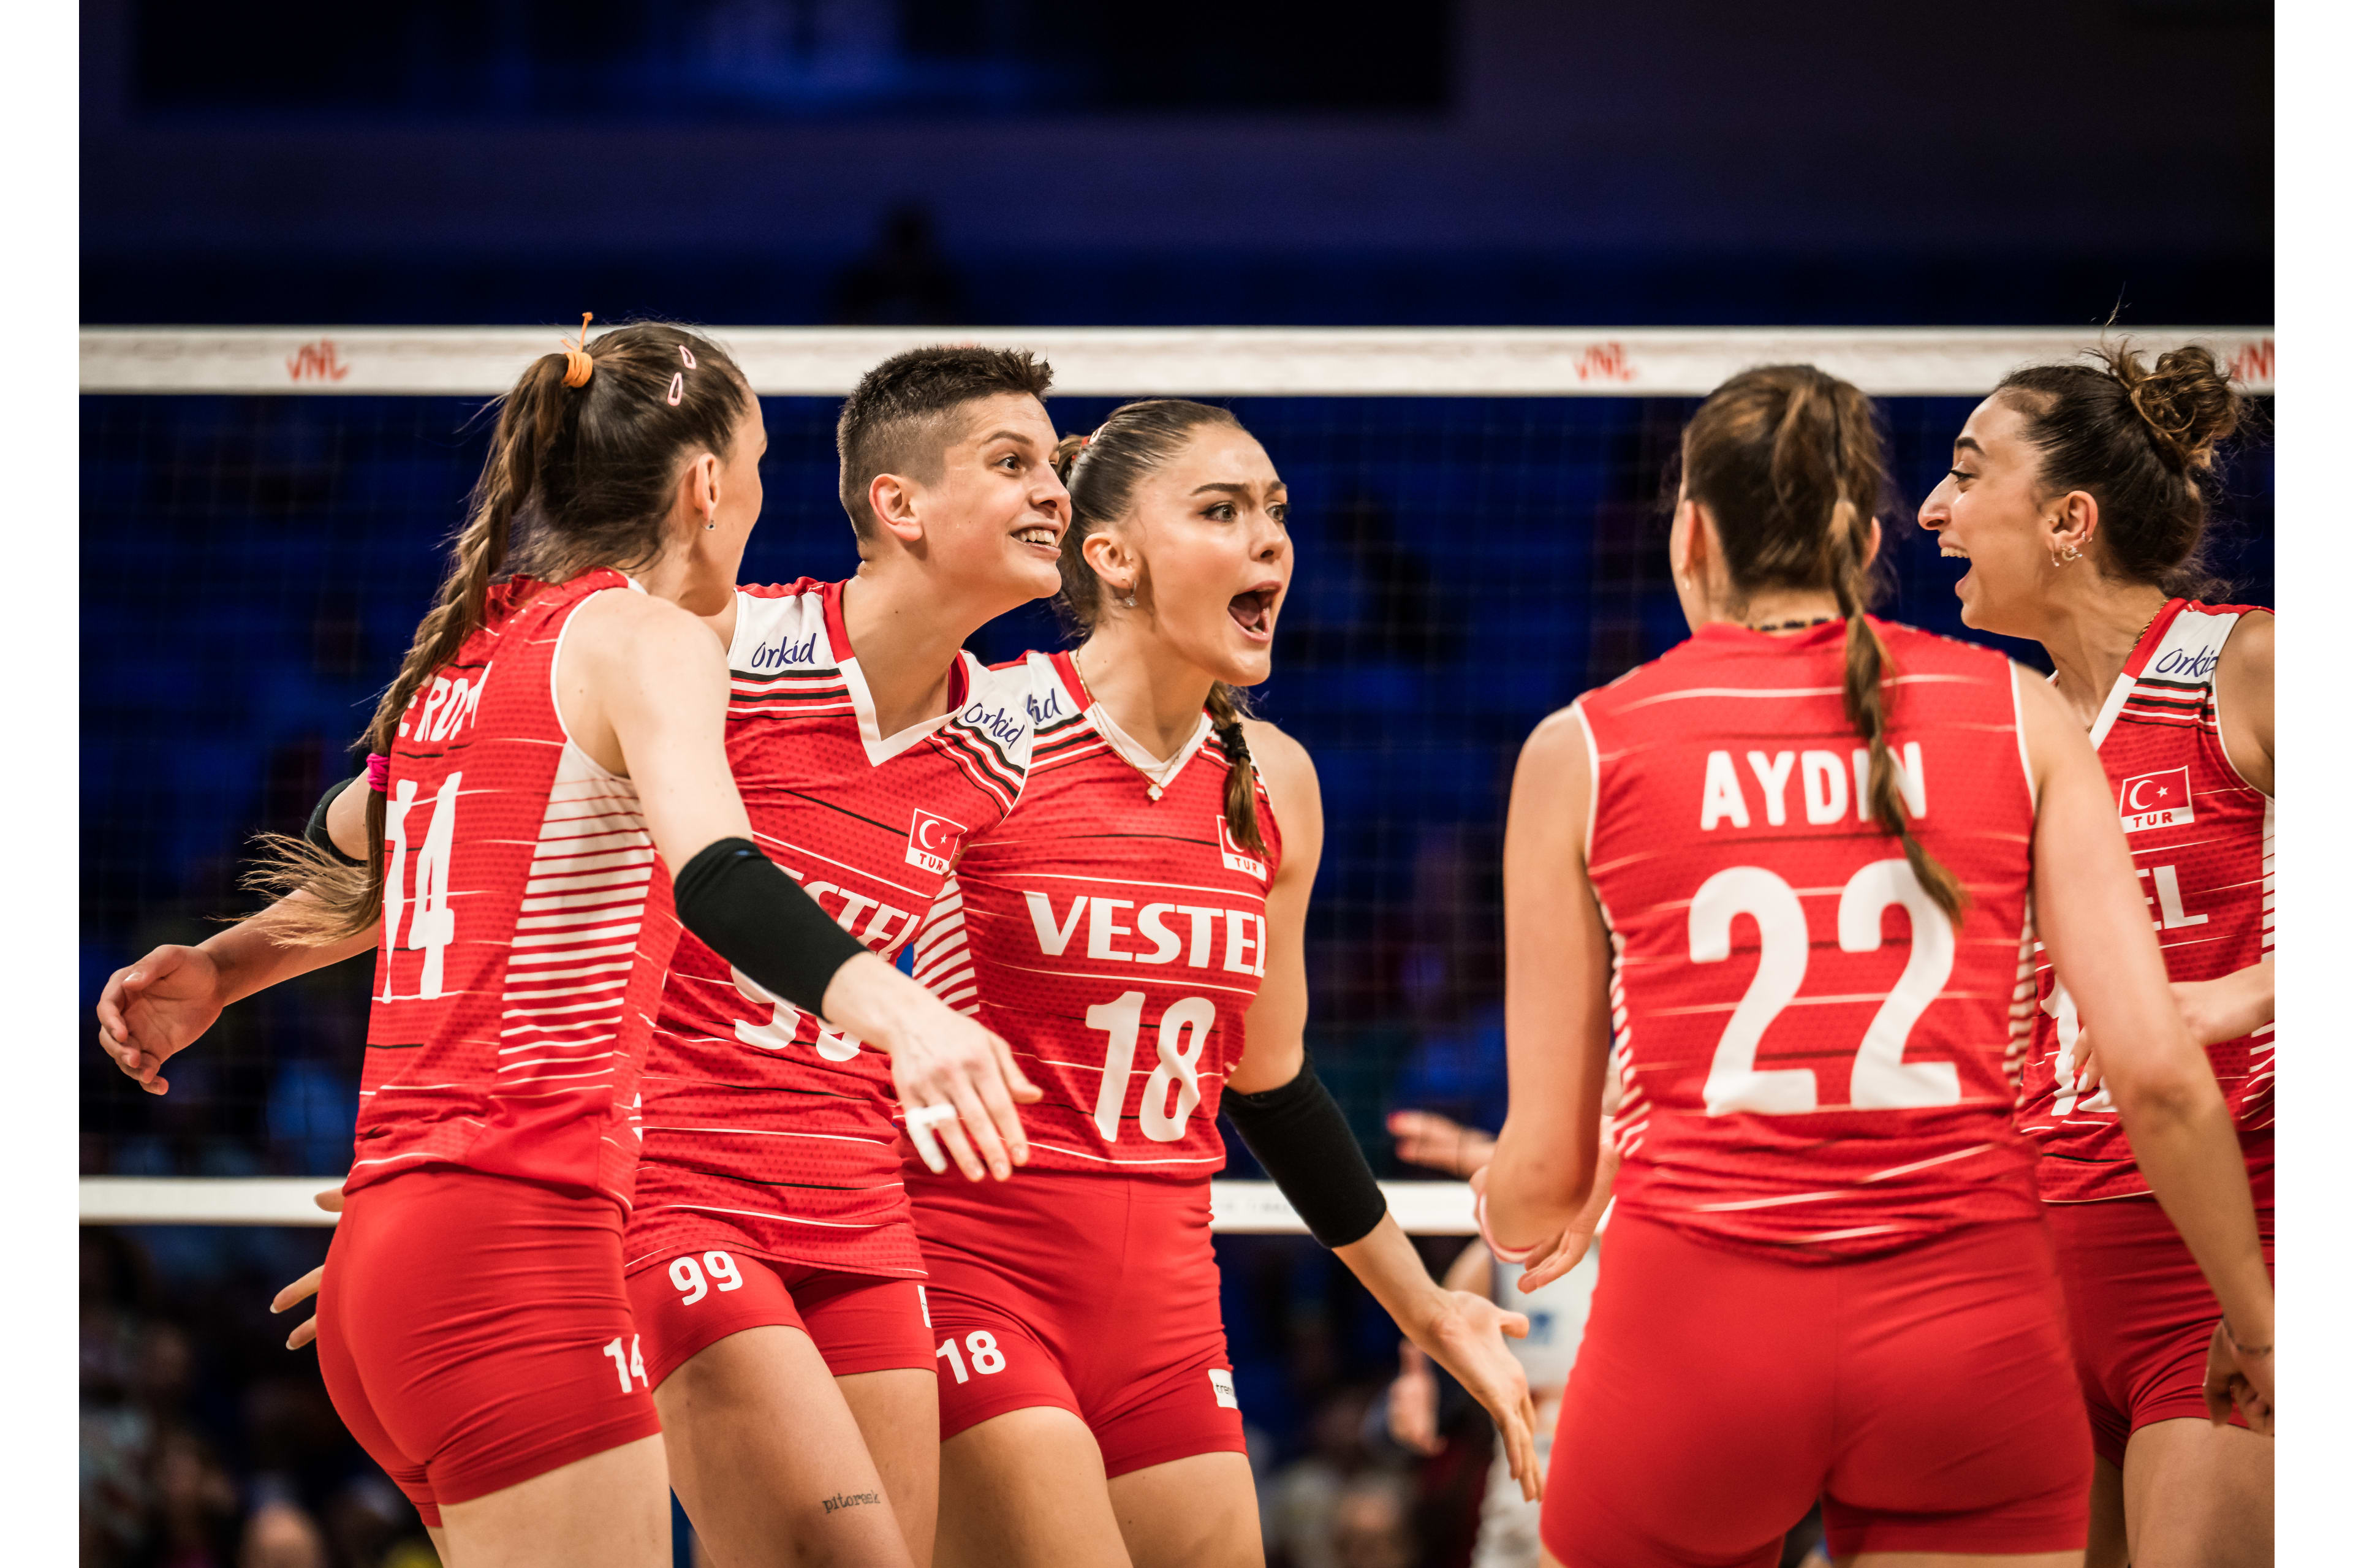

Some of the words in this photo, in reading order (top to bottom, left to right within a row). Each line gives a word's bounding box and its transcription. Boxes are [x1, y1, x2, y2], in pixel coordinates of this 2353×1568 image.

[751, 632, 817, 668] Orkid
[964, 702, 1025, 750] Orkid
[2132, 812, 2173, 828] TUR
[385, 771, 455, 1004] 14
[920, 852, 944, 871] TUR
[1234, 857, 1258, 874] TUR
[1023, 890, 1266, 978] VESTEL
[1688, 859, 1961, 1117] 22
[1085, 991, 1216, 1143] 18
[669, 1251, 743, 1306] 99
[603, 1333, 648, 1393] 14
[936, 1330, 1006, 1384] 18
